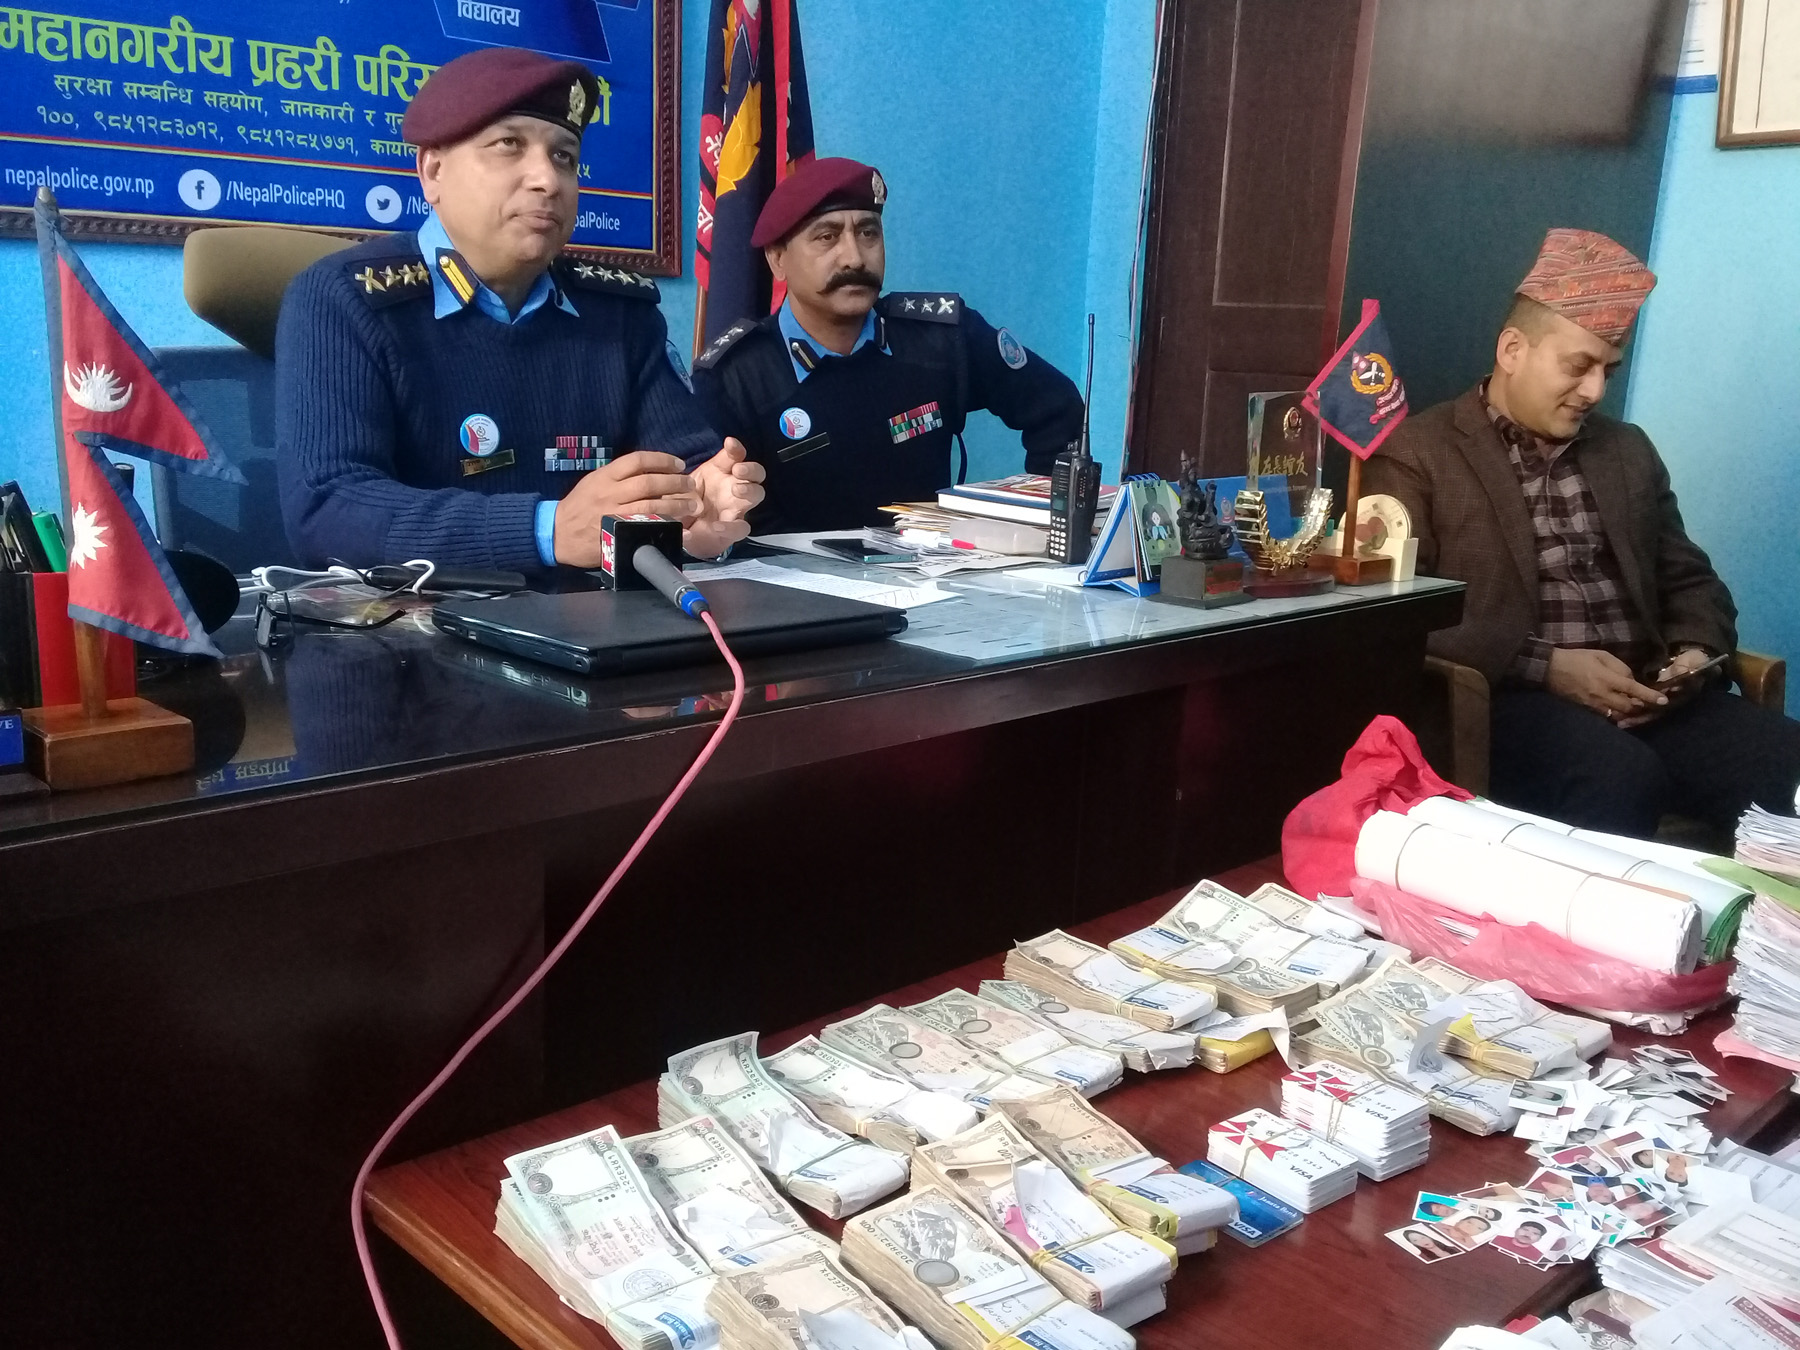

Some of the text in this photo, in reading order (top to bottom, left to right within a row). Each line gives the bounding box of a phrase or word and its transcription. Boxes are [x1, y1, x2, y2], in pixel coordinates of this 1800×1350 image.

[0, 7, 233, 77] महानगरीय
[247, 36, 341, 92] प्रहरी
[54, 74, 112, 100] सुरक्षा
[204, 90, 268, 116] सहयोग,
[280, 99, 354, 125] जानकारी
[364, 110, 376, 126] र
[5, 166, 154, 195] nepalpolice.gov.np
[226, 181, 346, 209] /NepalPolicePHQ
[1364, 1106, 1388, 1122] VISA
[592, 1133, 608, 1153] 1000
[1289, 1163, 1313, 1181] VISA
[1279, 1204, 1298, 1219] Bank
[1233, 1219, 1256, 1237] VISA
[672, 1318, 691, 1341] Janata
